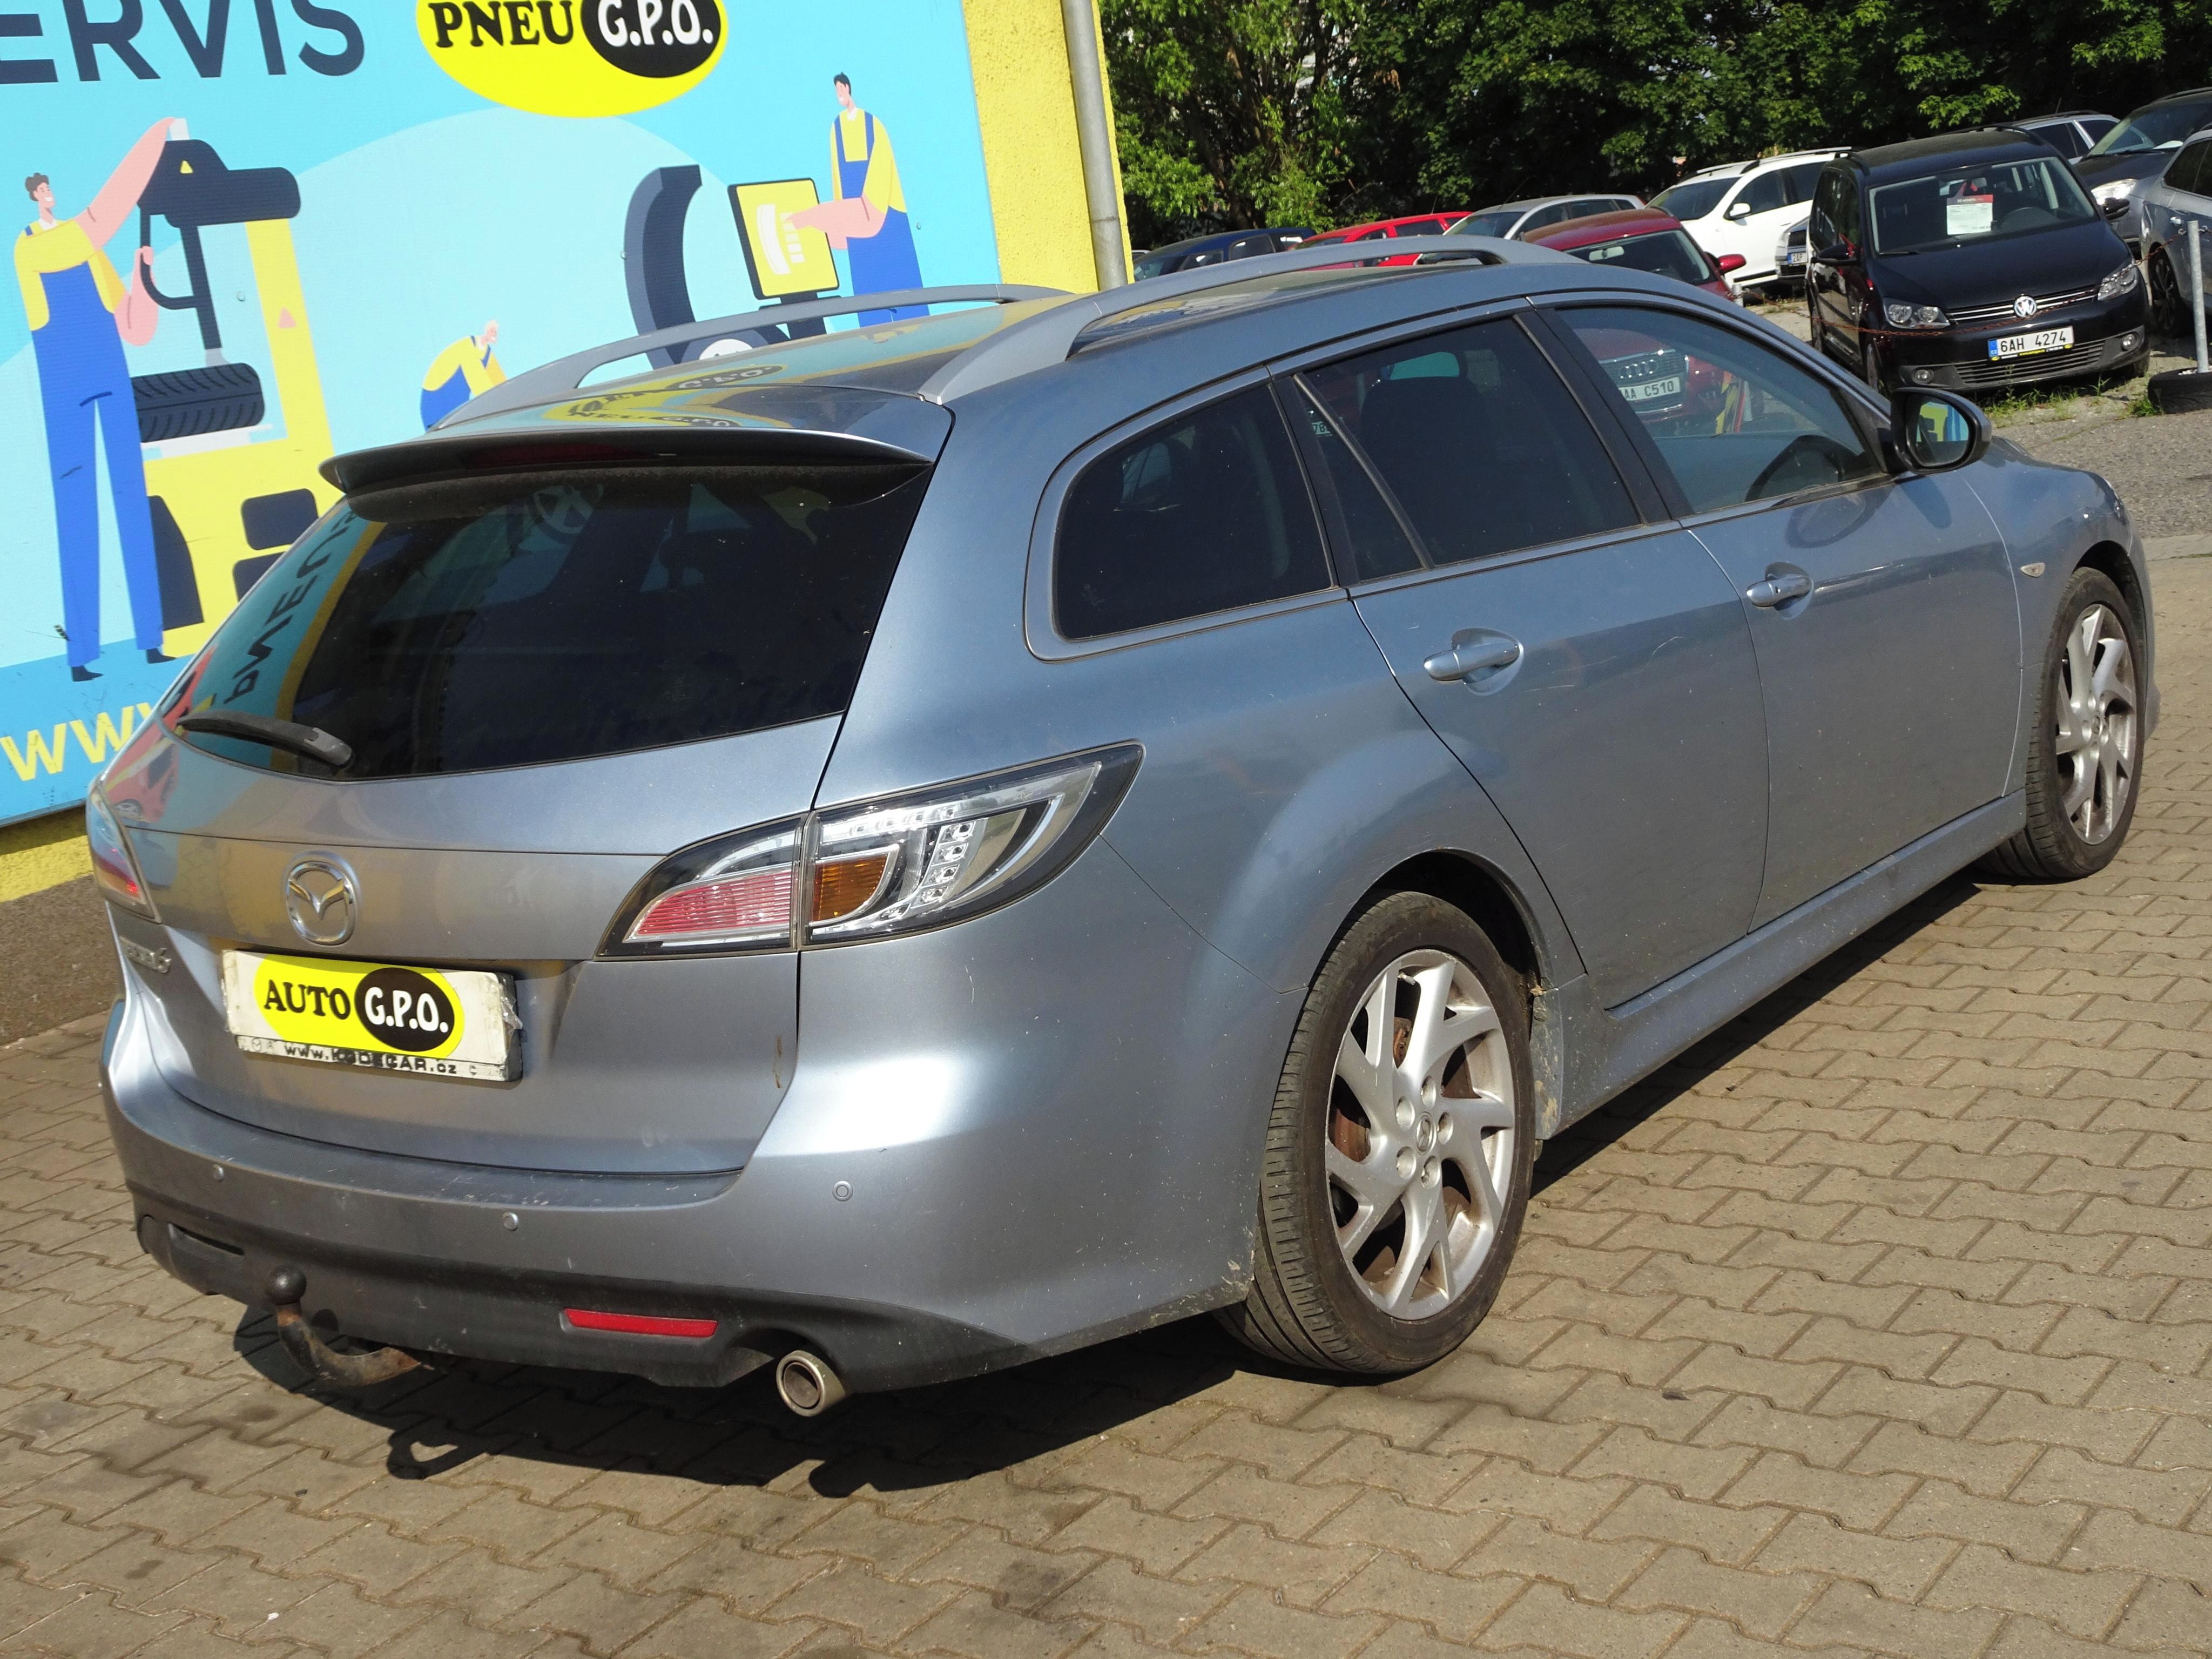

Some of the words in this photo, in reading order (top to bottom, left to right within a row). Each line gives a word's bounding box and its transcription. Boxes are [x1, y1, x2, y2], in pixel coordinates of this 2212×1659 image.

[429, 0, 574, 48] PNEU
[2001, 338, 2025, 352] 6AH
[2035, 330, 2066, 347] 4274
[1644, 381, 1674, 397] C510
[264, 979, 351, 1020] AUTO
[364, 986, 449, 1033] G.P.O.
